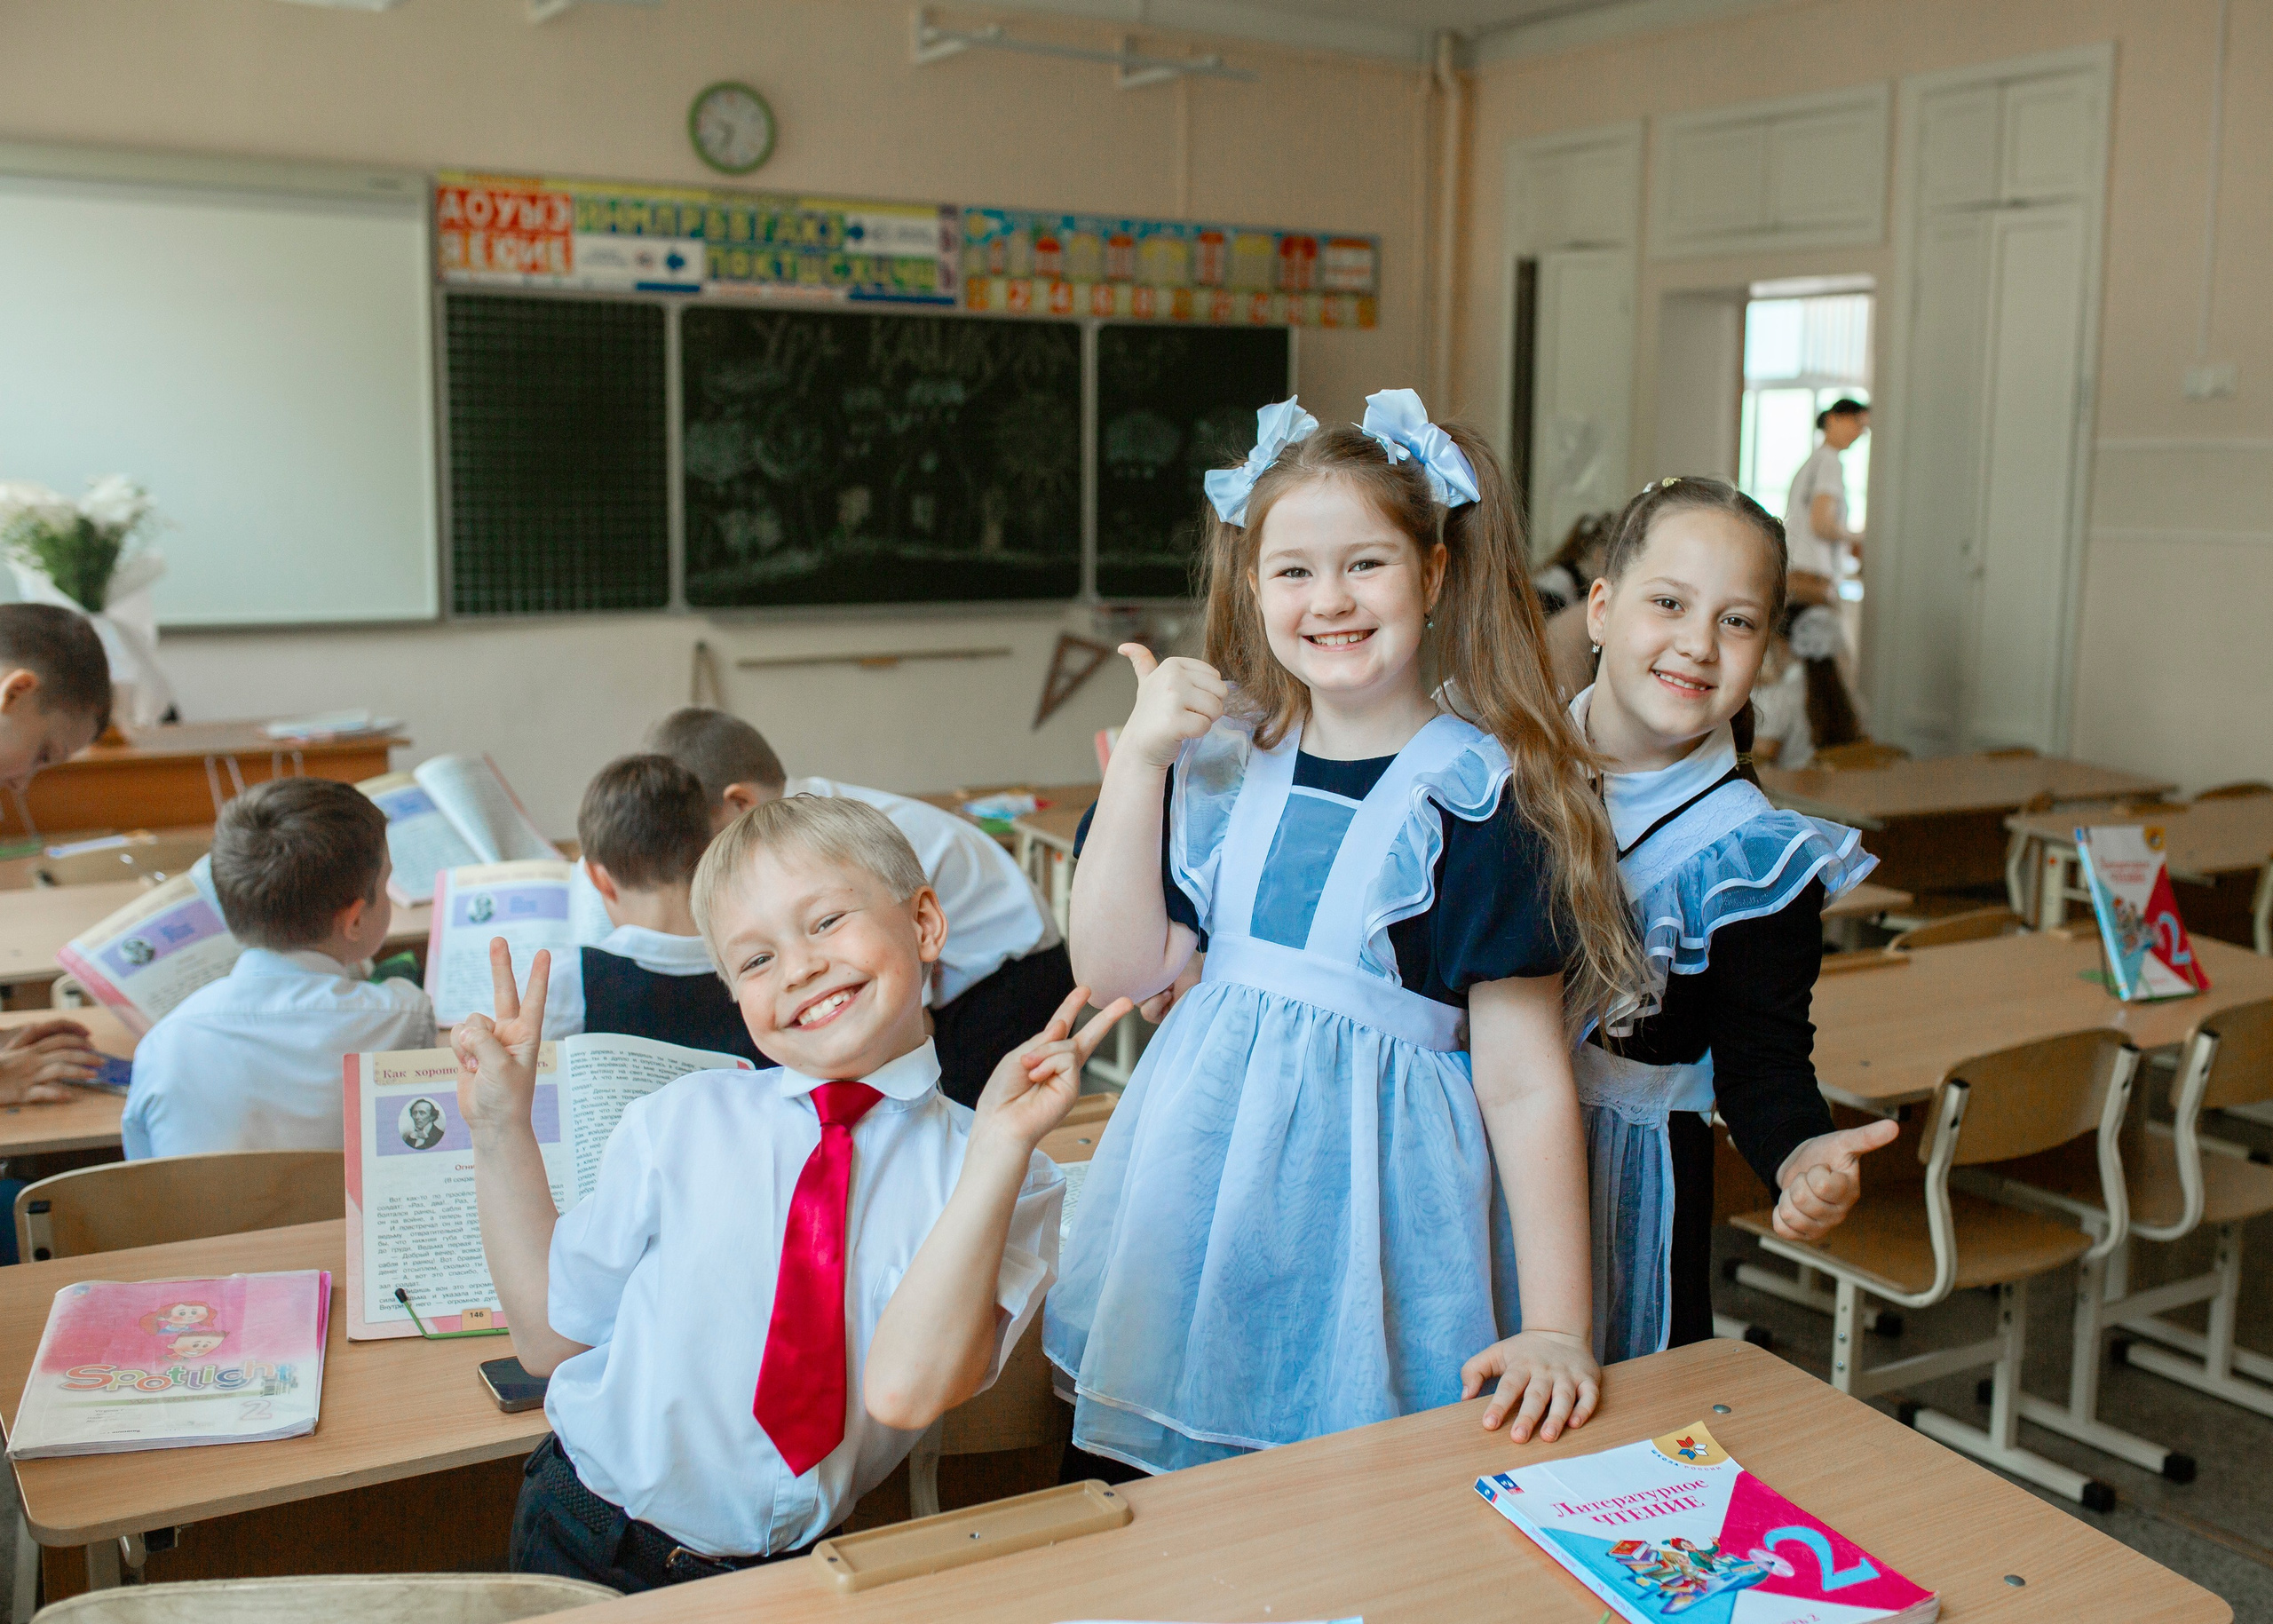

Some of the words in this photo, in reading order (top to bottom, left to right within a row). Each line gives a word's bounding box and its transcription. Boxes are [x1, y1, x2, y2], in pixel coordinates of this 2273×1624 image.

[2158, 913, 2191, 965] 2
[383, 1069, 407, 1079] Как
[399, 1222, 439, 1231] повстречал
[410, 1227, 463, 1237] отвратительной
[239, 1400, 273, 1422] 2
[1651, 1449, 1679, 1467] ШКОЛА
[1550, 1479, 1709, 1517] Литературное
[1589, 1495, 1707, 1526] ЧТЕНИЕ
[1764, 1526, 1882, 1592] 2
[1806, 1613, 1821, 1622] 2
